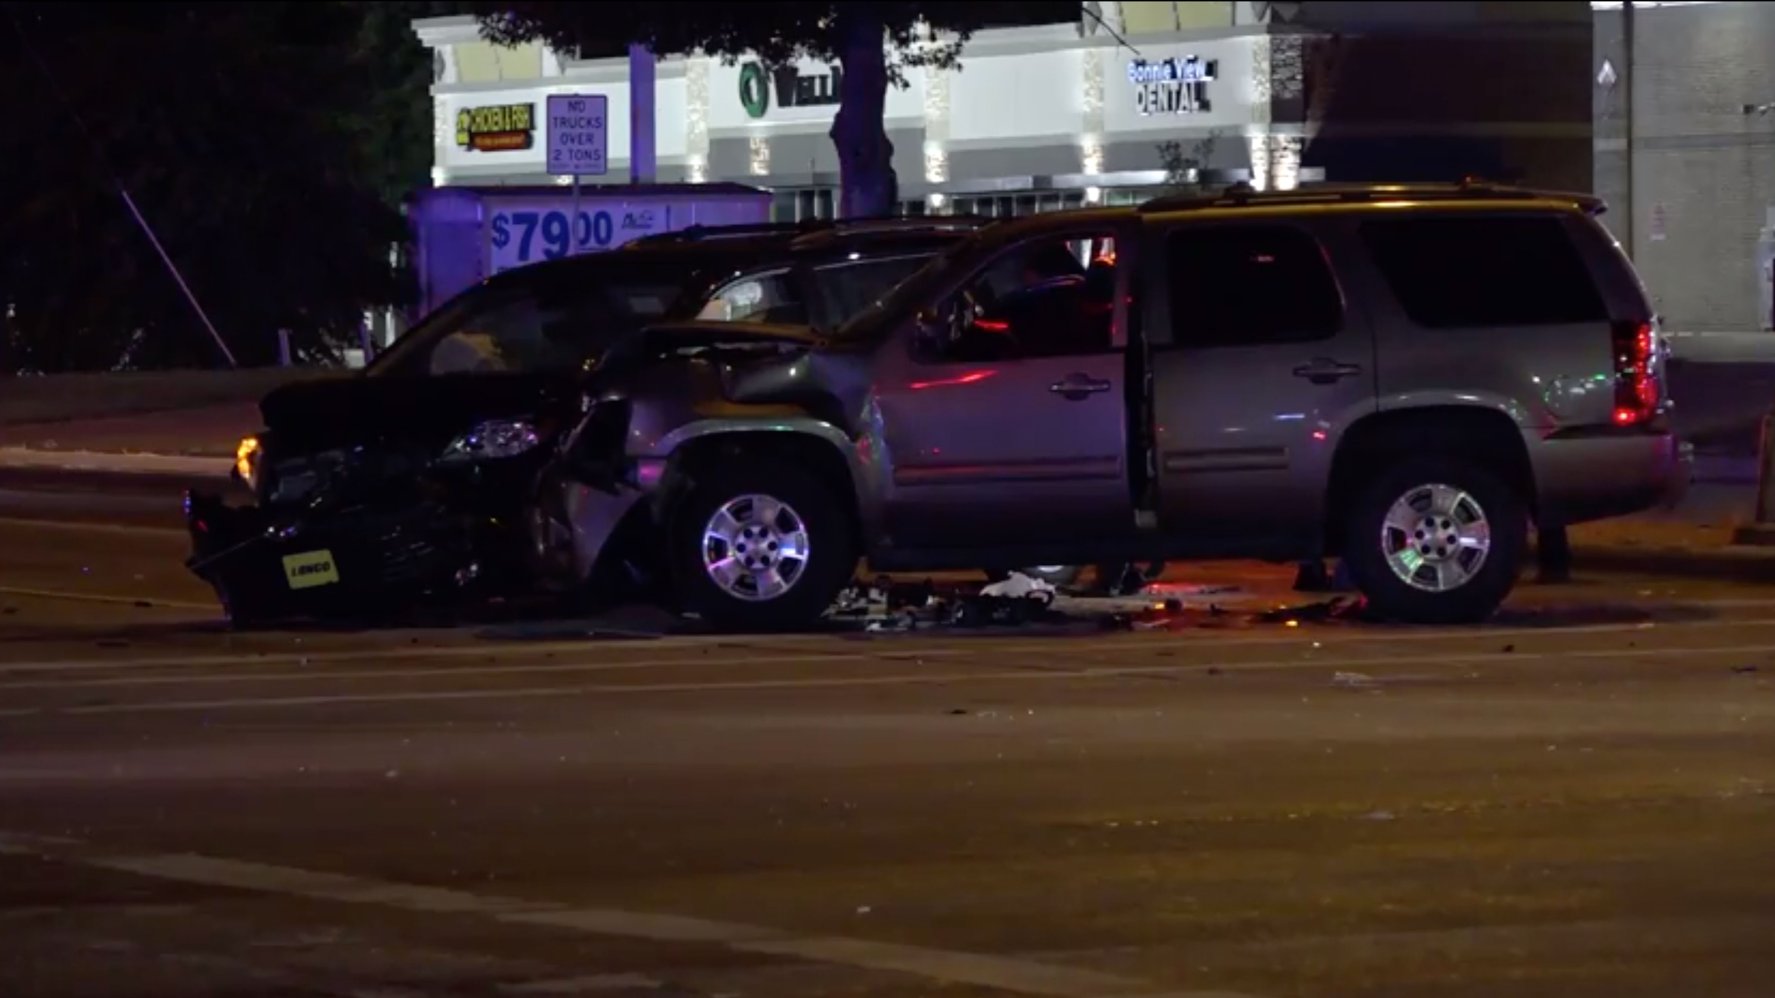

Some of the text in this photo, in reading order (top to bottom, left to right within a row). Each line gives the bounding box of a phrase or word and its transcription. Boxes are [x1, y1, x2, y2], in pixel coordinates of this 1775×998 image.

[1136, 83, 1207, 114] DENTAL
[568, 100, 586, 113] NO
[553, 116, 602, 129] TRUCKS
[560, 132, 595, 146] OVER
[552, 149, 601, 161] 2 TONS
